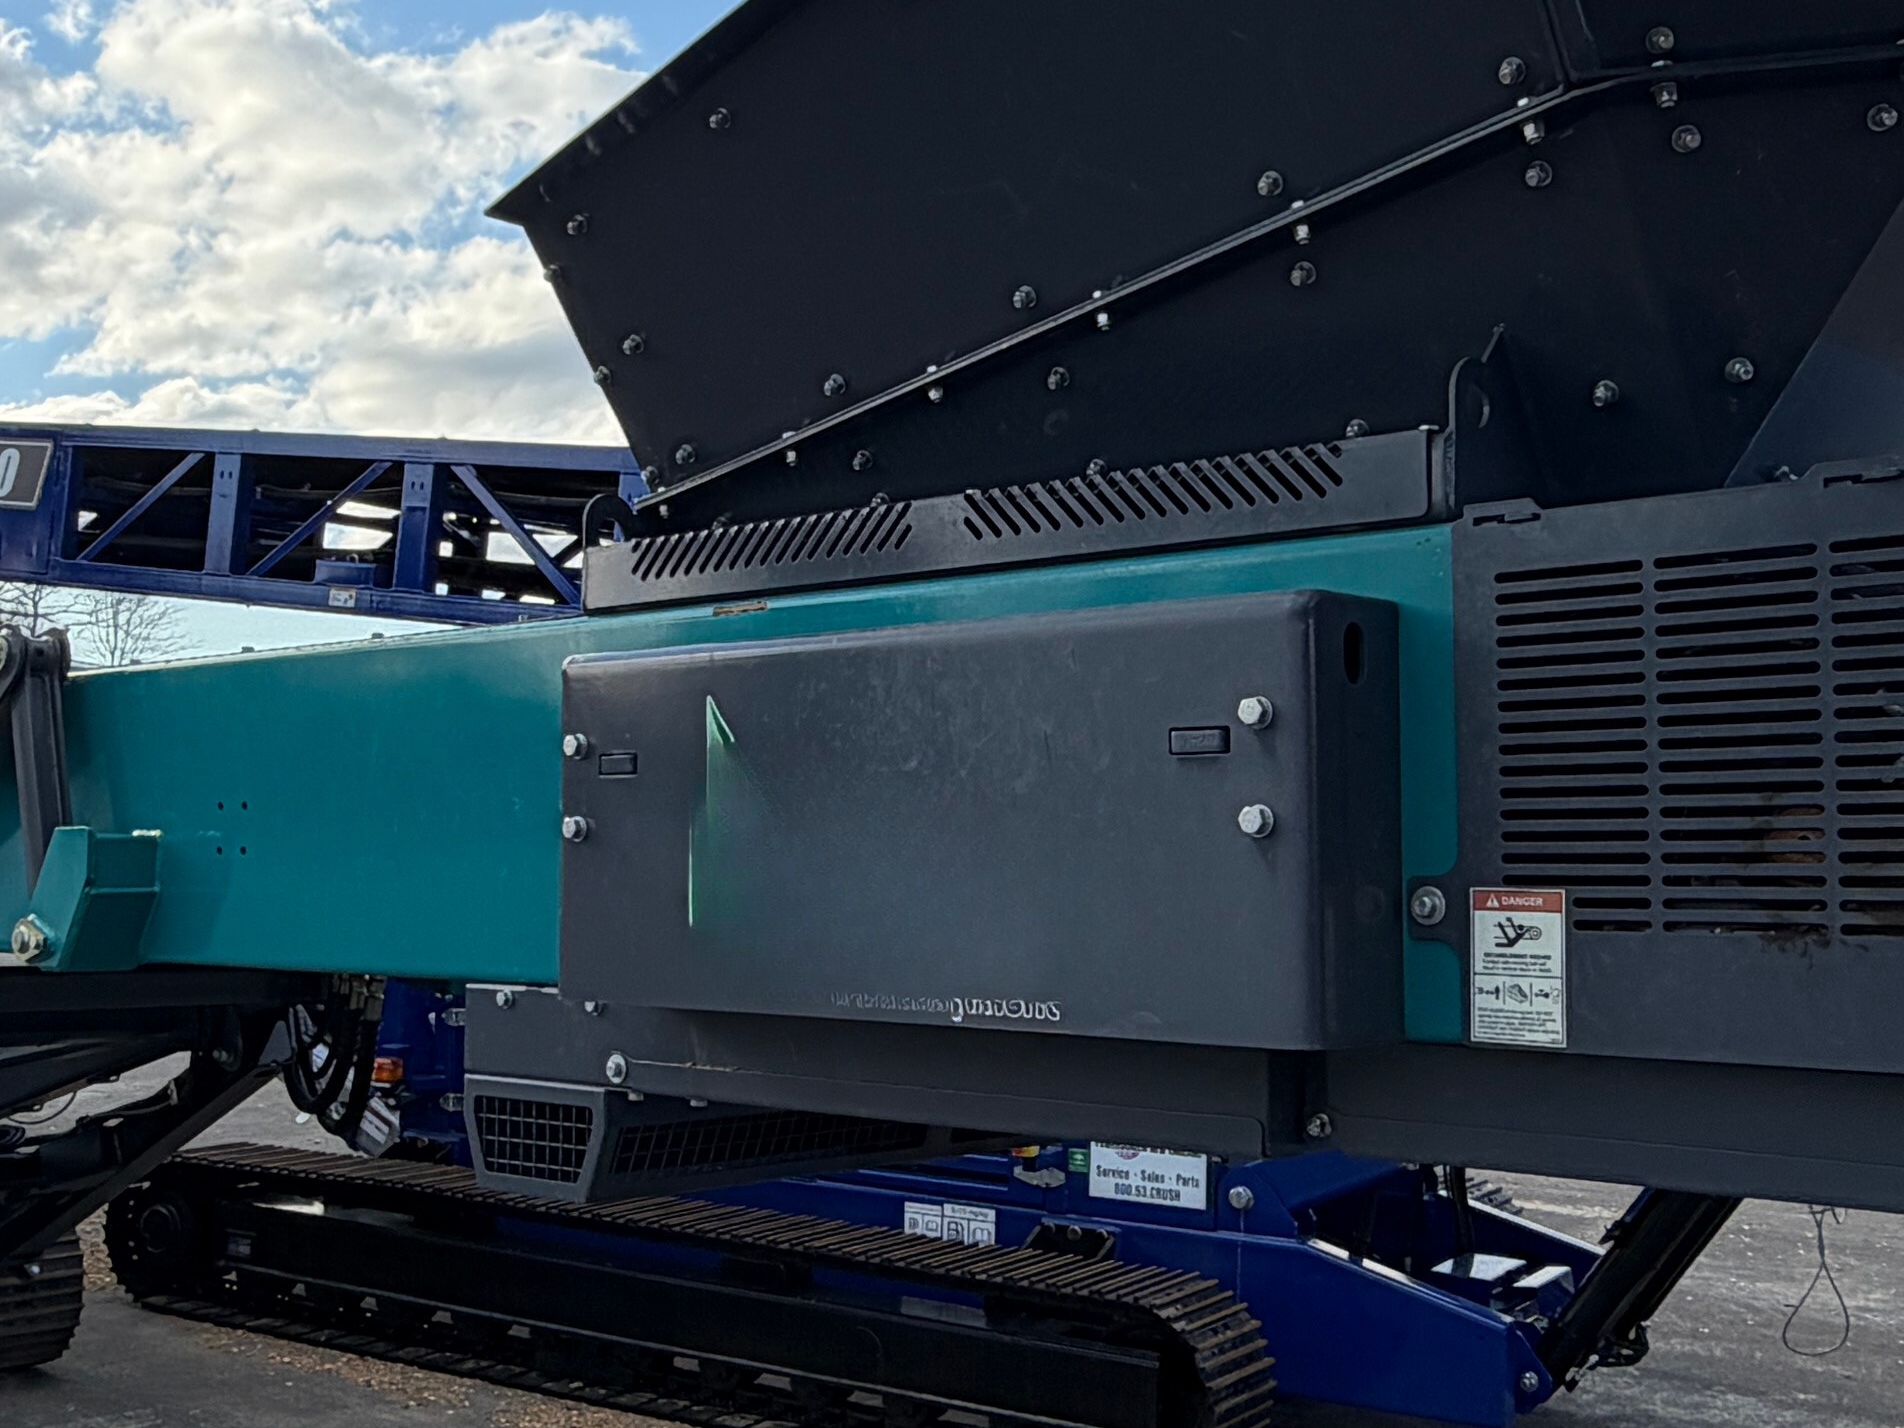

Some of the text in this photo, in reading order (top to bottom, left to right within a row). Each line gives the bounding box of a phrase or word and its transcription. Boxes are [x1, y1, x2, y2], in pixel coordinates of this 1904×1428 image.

[1501, 896, 1543, 906] DANGER
[1096, 1164, 1200, 1189] Service Sales Parts
